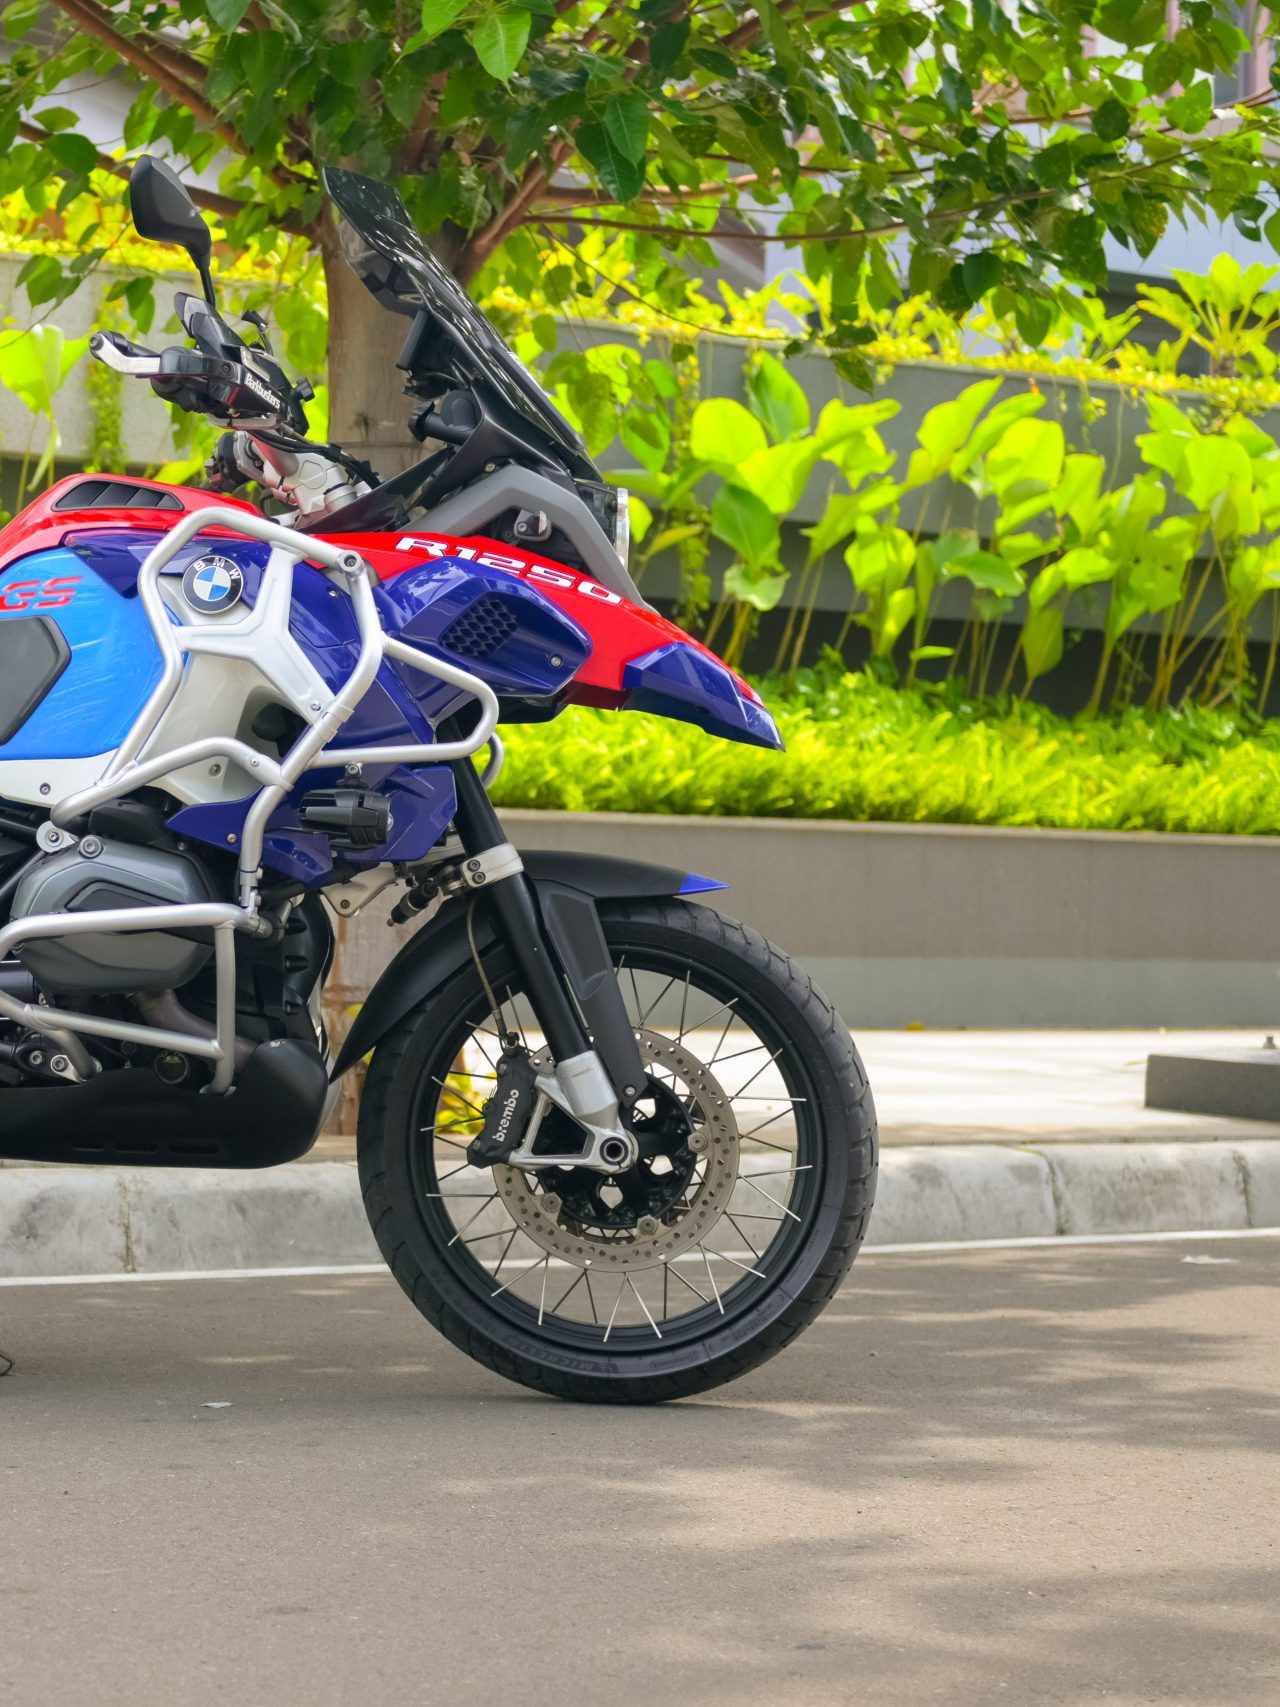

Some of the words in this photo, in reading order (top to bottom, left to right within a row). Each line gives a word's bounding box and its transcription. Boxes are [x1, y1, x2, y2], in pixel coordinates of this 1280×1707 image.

[193, 557, 241, 579] BMW
[395, 537, 623, 604] R1250
[492, 1088, 520, 1142] brembo
